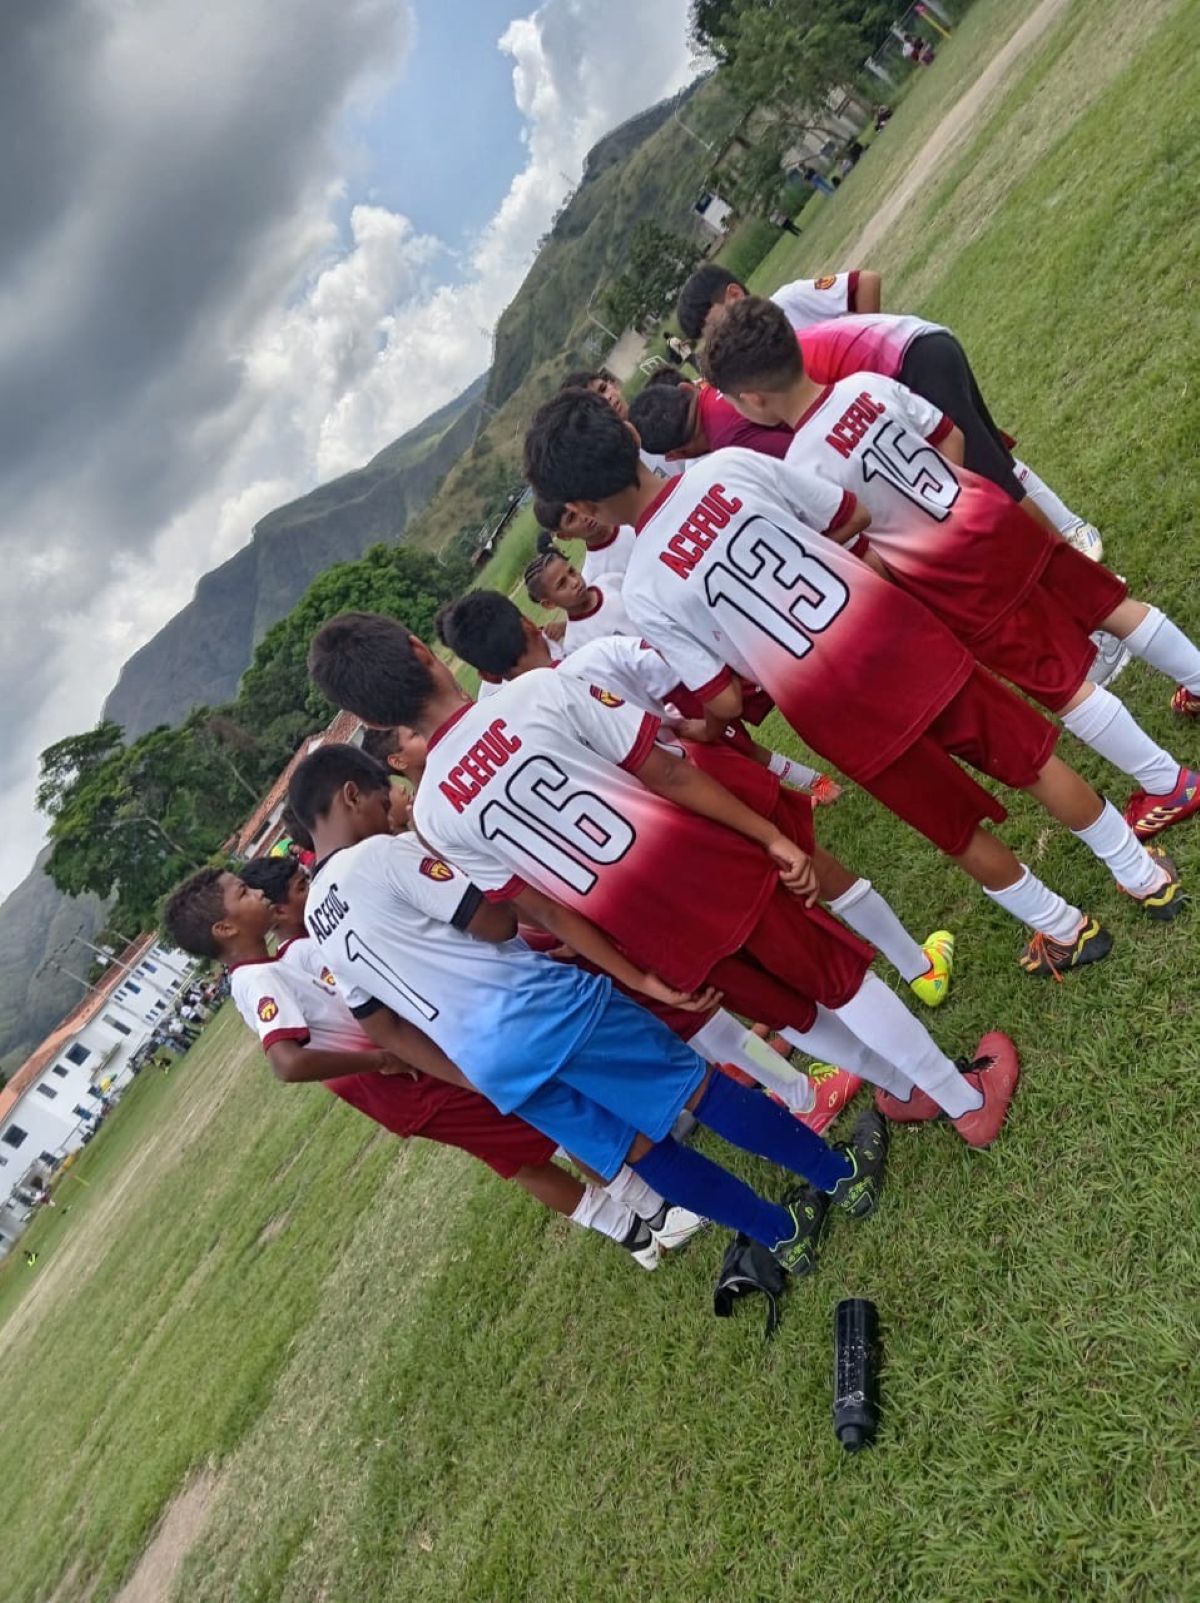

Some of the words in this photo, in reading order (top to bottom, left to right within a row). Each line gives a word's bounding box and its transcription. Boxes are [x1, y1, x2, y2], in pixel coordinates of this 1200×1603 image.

[826, 392, 885, 458] ACEFUC
[862, 421, 960, 522] 15
[659, 483, 743, 580] ACEFUC
[704, 515, 850, 659] 13
[438, 718, 522, 814] ACEFUC
[479, 754, 637, 896] 16
[345, 930, 439, 1022] 1
